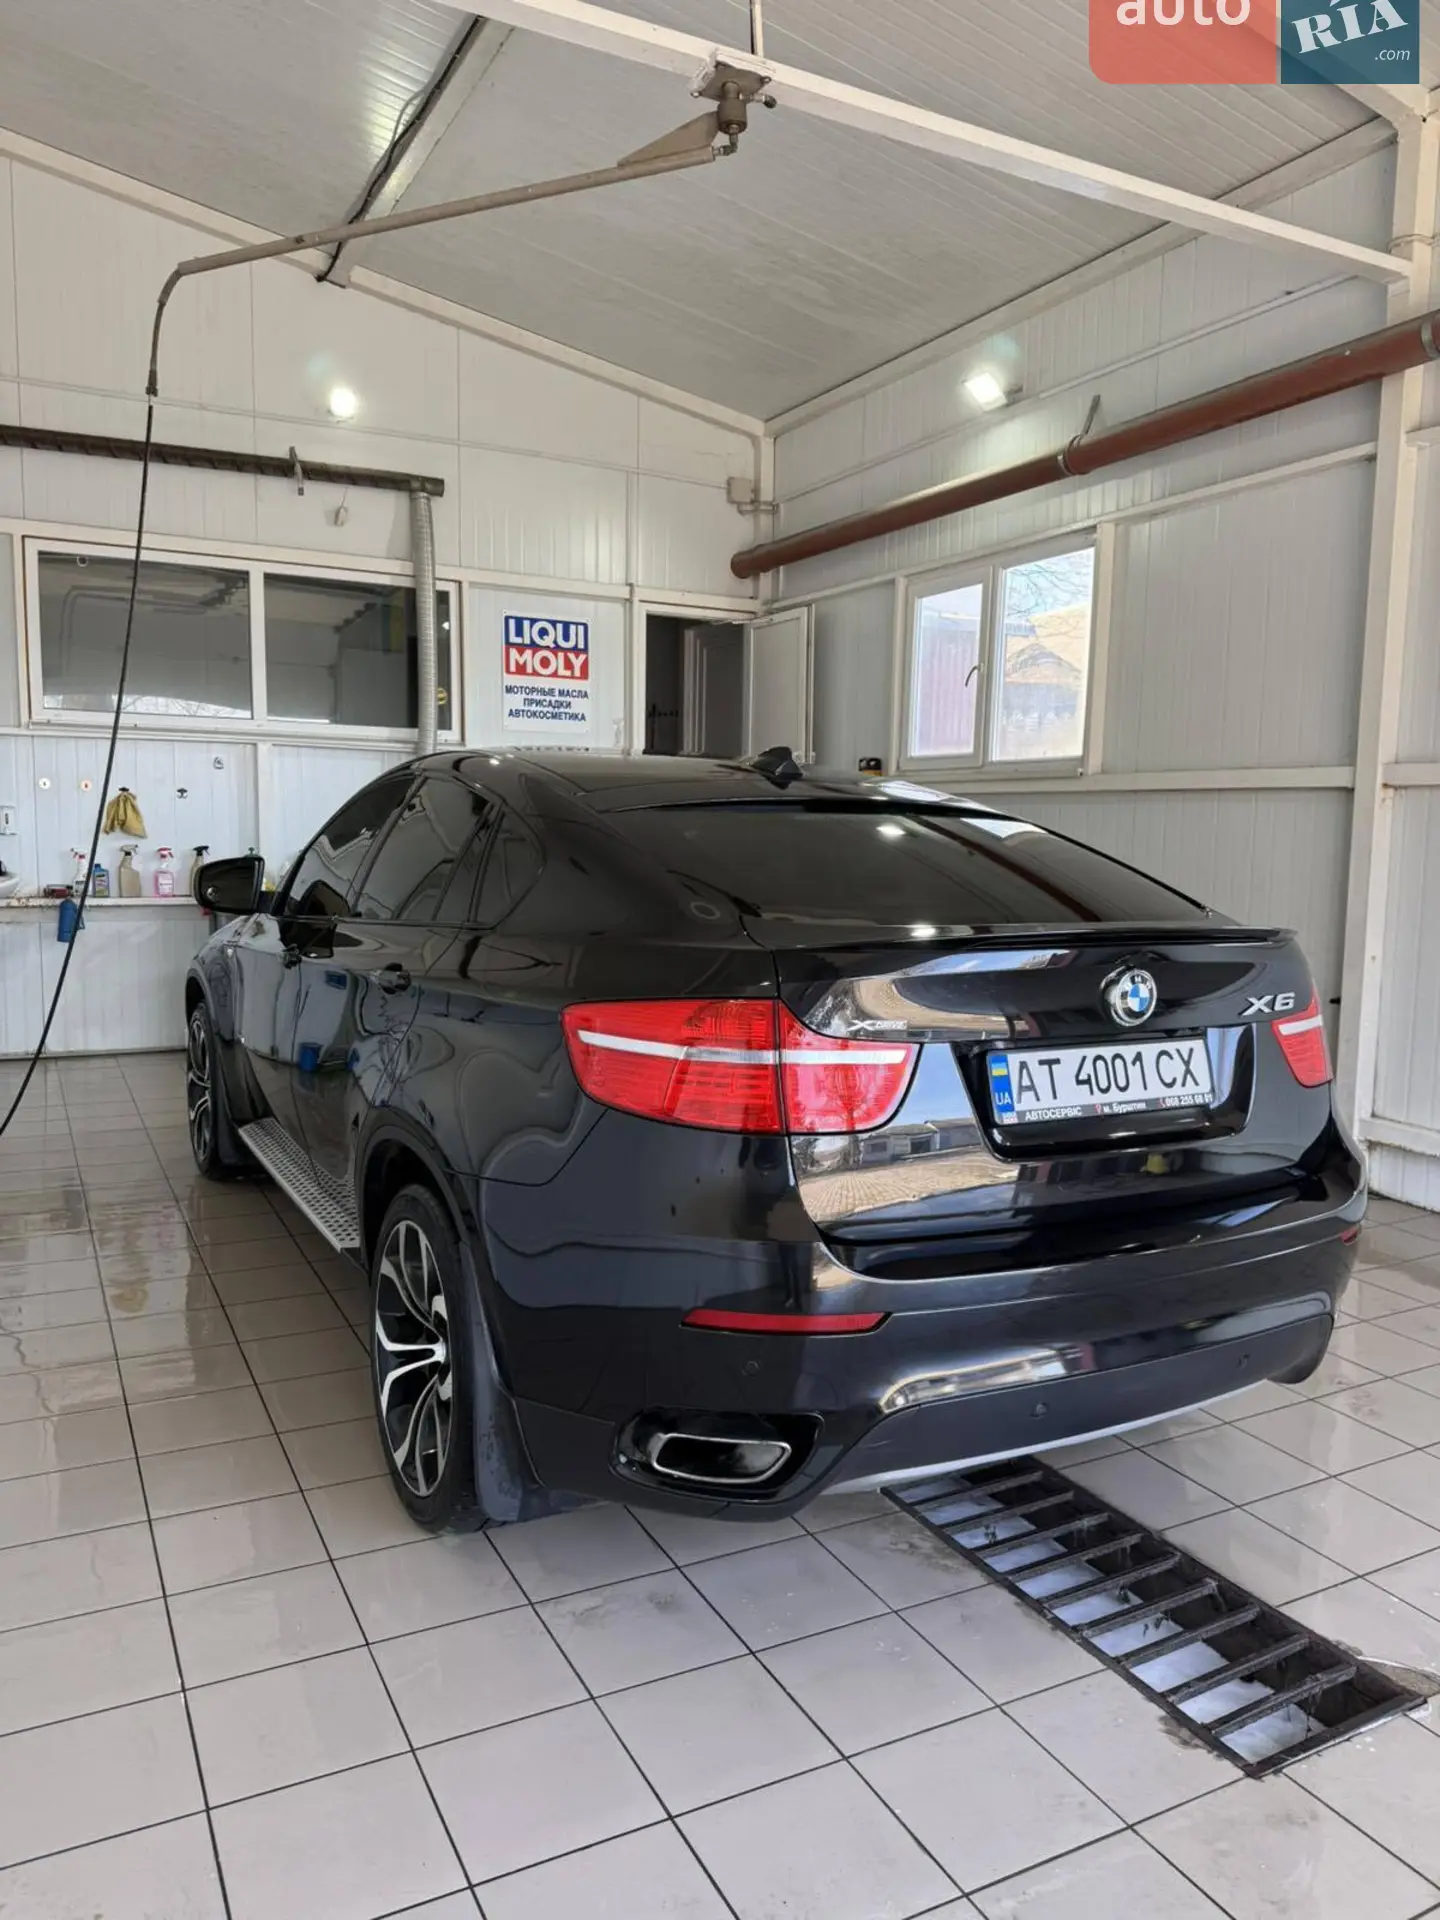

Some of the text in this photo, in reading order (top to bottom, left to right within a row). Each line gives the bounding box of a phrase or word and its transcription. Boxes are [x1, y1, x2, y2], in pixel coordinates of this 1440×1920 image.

[508, 618, 585, 649] LIQUI
[509, 648, 587, 677] MOLY
[505, 685, 589, 699] МОТОРНЫЕ МАСЛА
[523, 698, 572, 710] ПРИСАДКИ
[508, 709, 586, 722] АВТОКОСМЕТИКА
[1241, 991, 1296, 1016] X6
[1075, 1051, 1148, 1096] 4001
[995, 1091, 1012, 1105] UA
[1025, 1107, 1083, 1121] АВТОСЕРВІС
